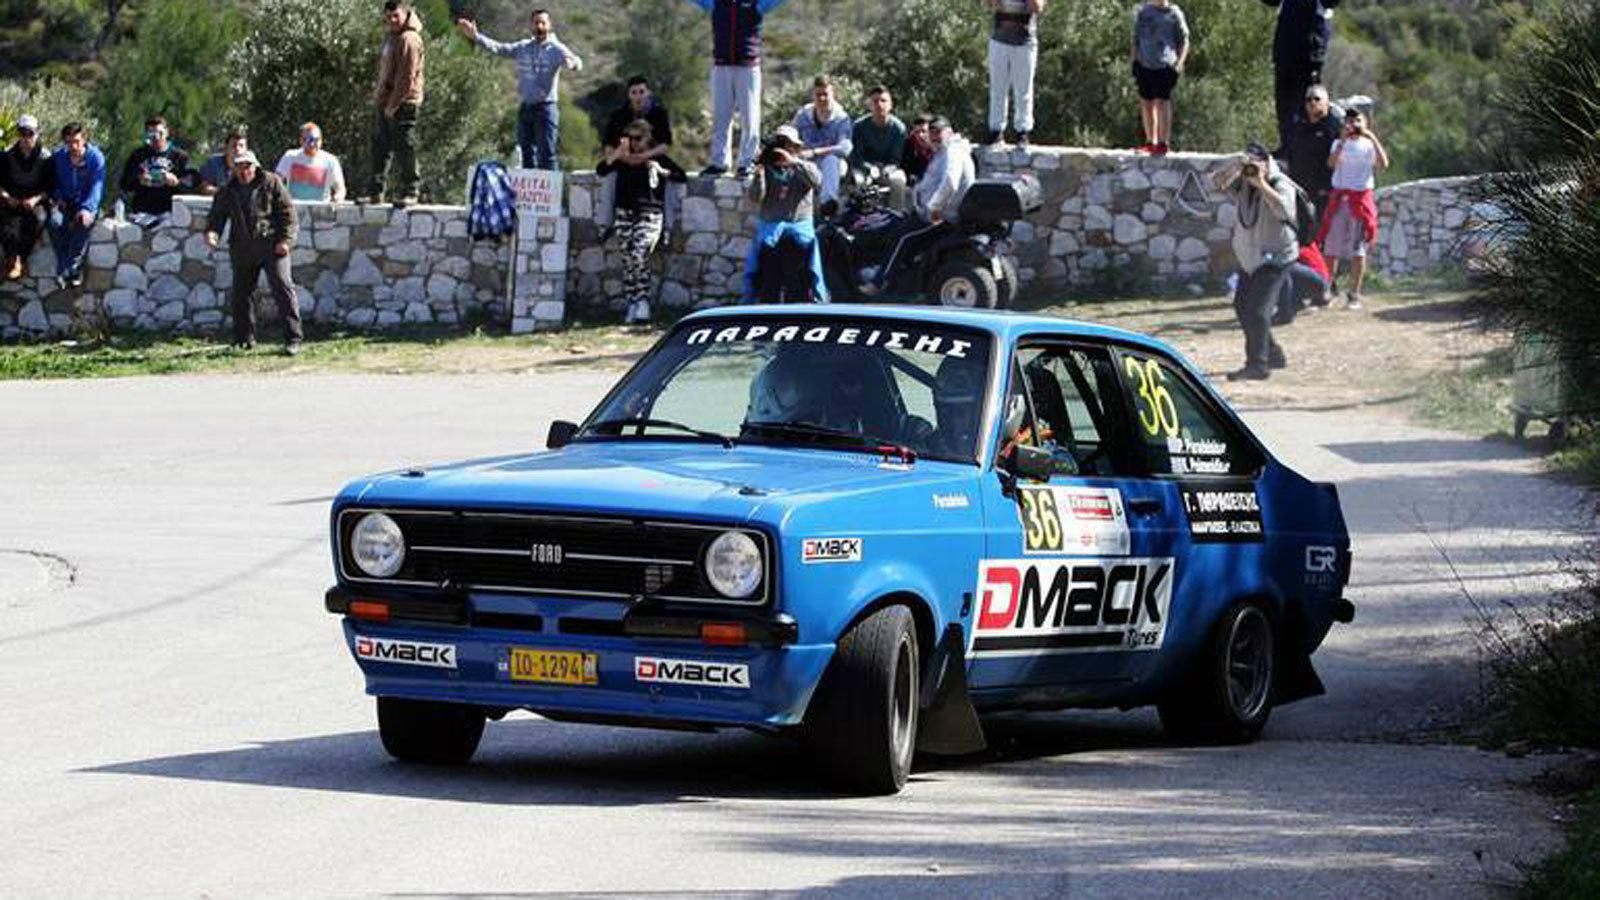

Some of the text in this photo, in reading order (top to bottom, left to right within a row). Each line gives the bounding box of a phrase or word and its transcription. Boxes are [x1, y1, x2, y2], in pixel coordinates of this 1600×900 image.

[1126, 356, 1178, 437] 36
[1022, 489, 1061, 549] 36
[532, 543, 562, 564] FORD
